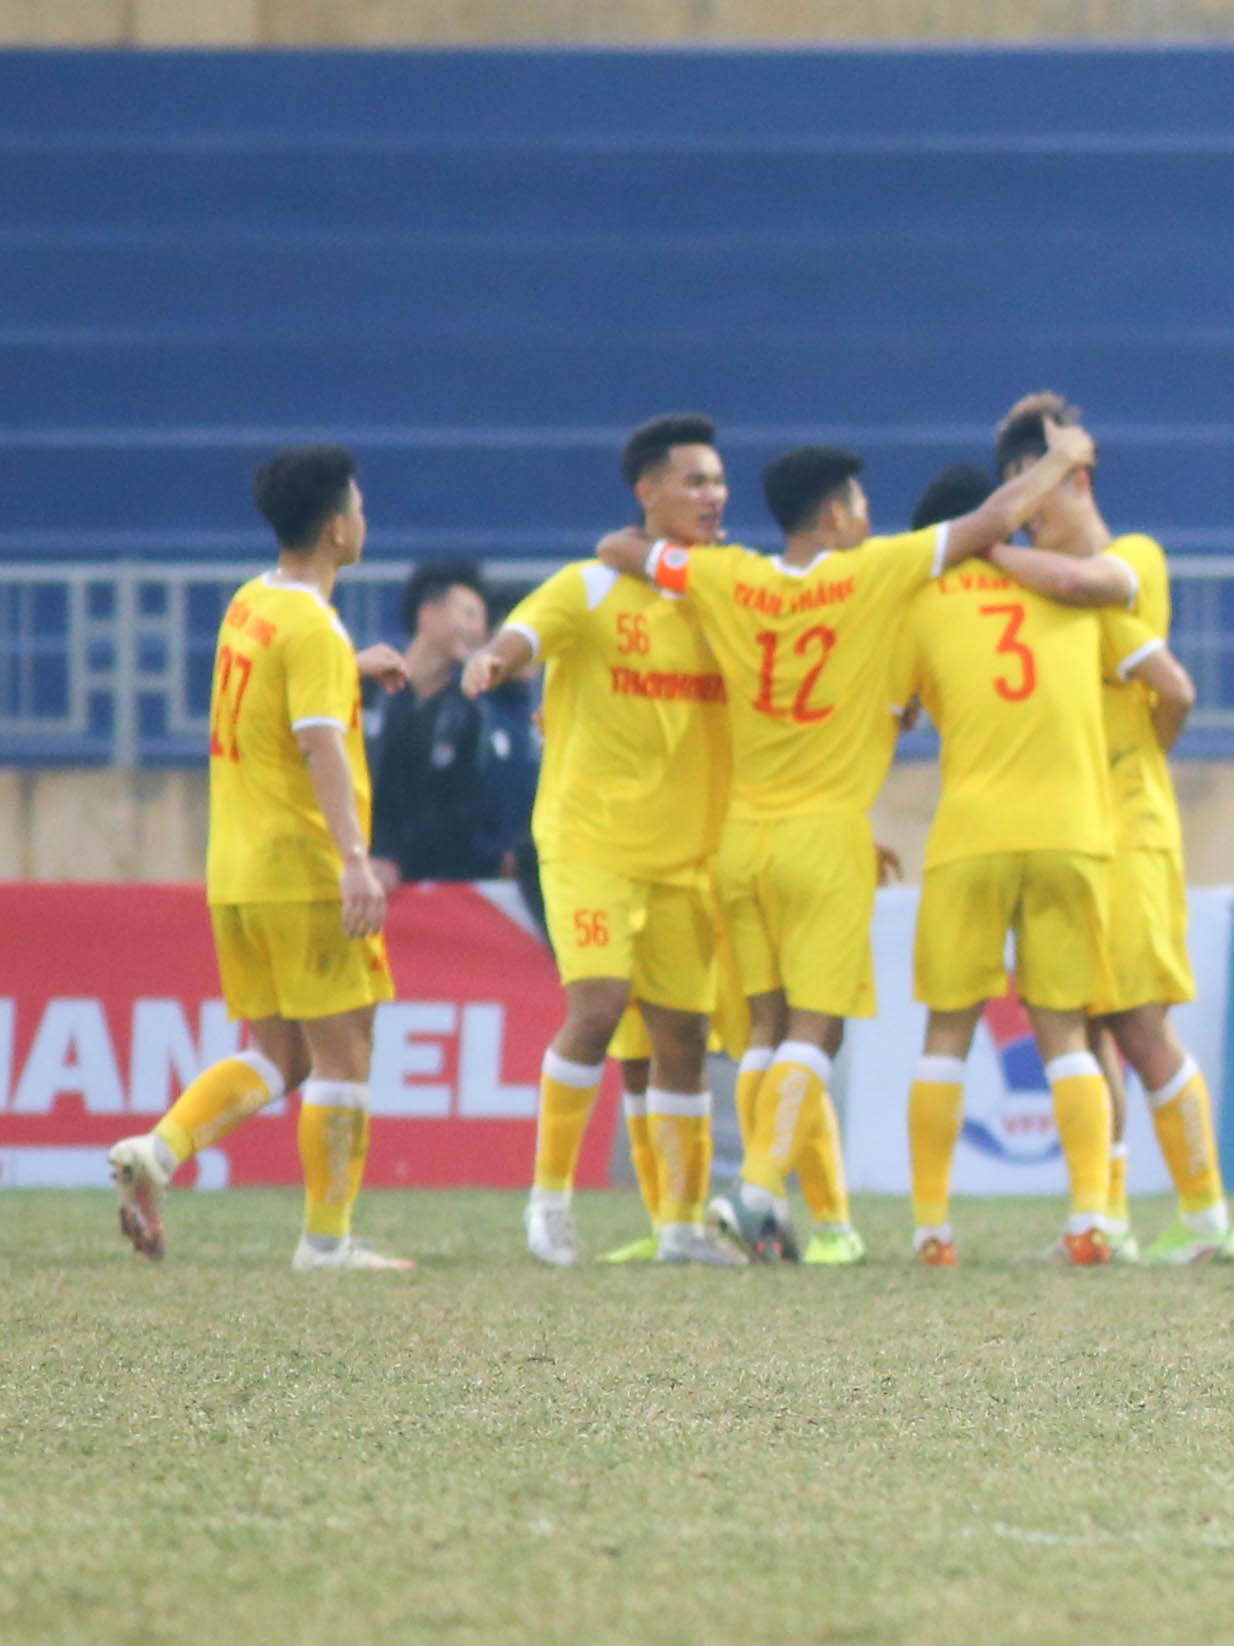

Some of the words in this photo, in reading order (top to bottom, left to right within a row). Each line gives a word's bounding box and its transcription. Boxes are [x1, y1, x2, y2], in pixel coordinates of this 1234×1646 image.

[616, 613, 650, 656] 56
[753, 624, 837, 724] 12
[980, 602, 1036, 703] 3
[574, 908, 609, 948] 56
[0, 996, 546, 1117] ANEL
